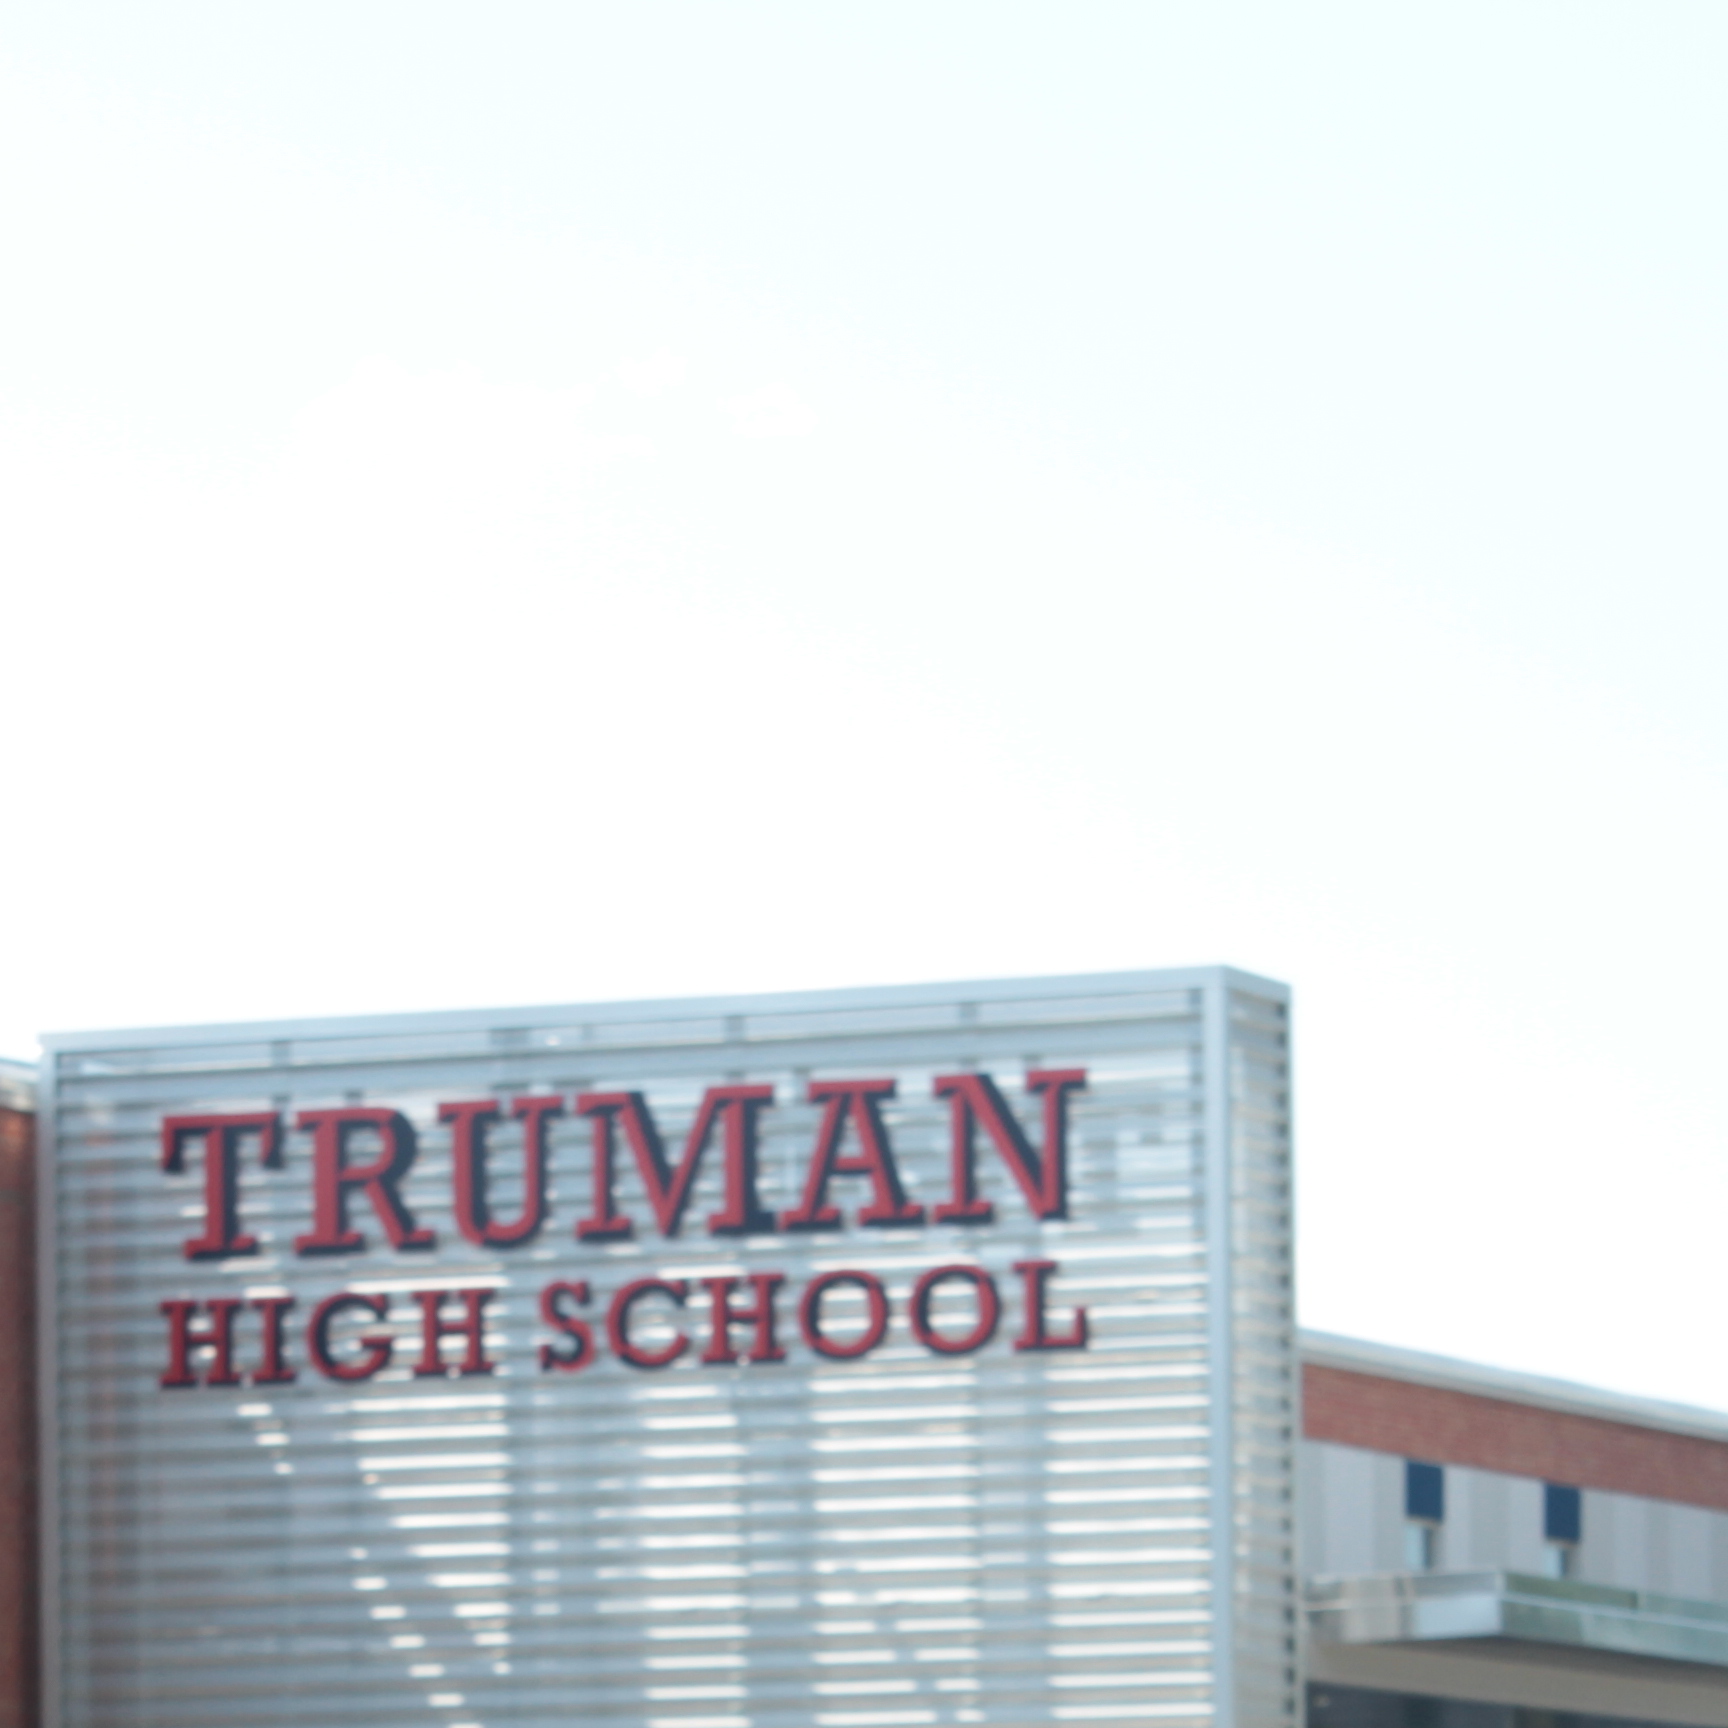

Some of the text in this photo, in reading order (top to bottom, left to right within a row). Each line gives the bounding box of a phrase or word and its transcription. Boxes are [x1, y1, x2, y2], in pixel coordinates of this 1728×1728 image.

[160, 1067, 1087, 1260] TRUMAN
[158, 1261, 1089, 1387] HIGH SCHOOL
